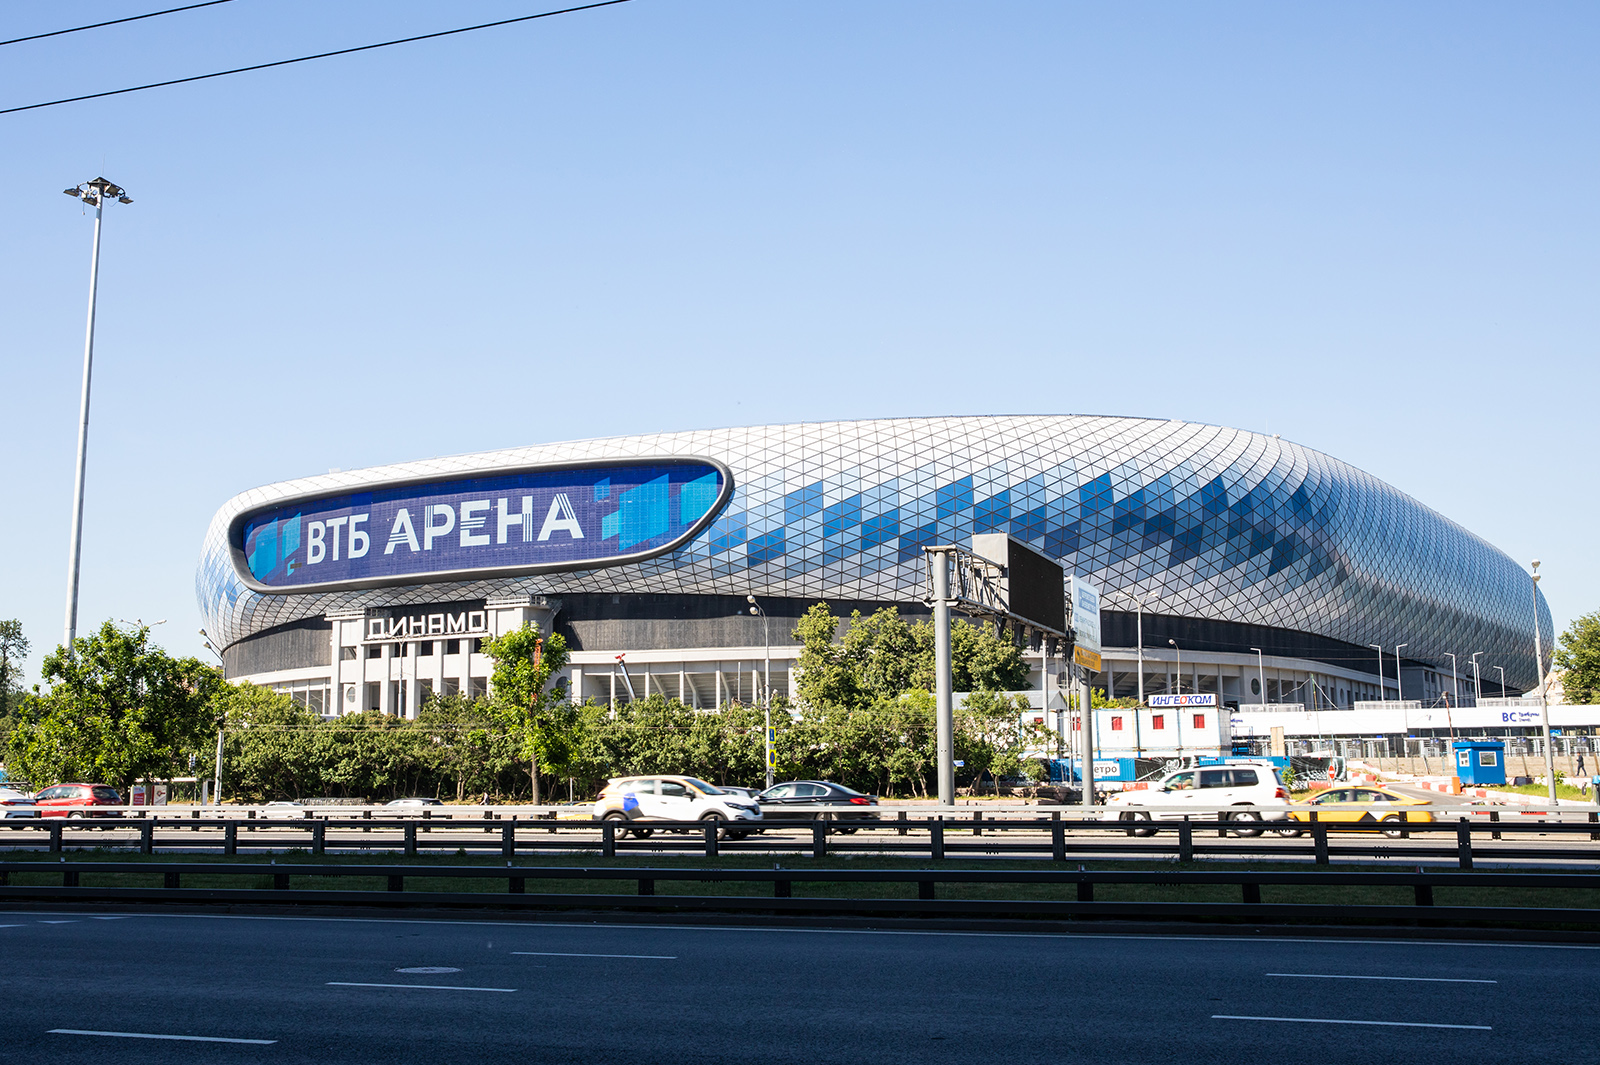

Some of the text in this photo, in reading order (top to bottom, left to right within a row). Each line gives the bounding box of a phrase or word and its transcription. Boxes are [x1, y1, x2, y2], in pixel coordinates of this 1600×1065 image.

[307, 493, 585, 565] ВТБ АРЕНА
[367, 611, 485, 639] ДИНАМО
[1152, 695, 1212, 705] ИНГЕОКОМ
[1093, 766, 1118, 775] етро
